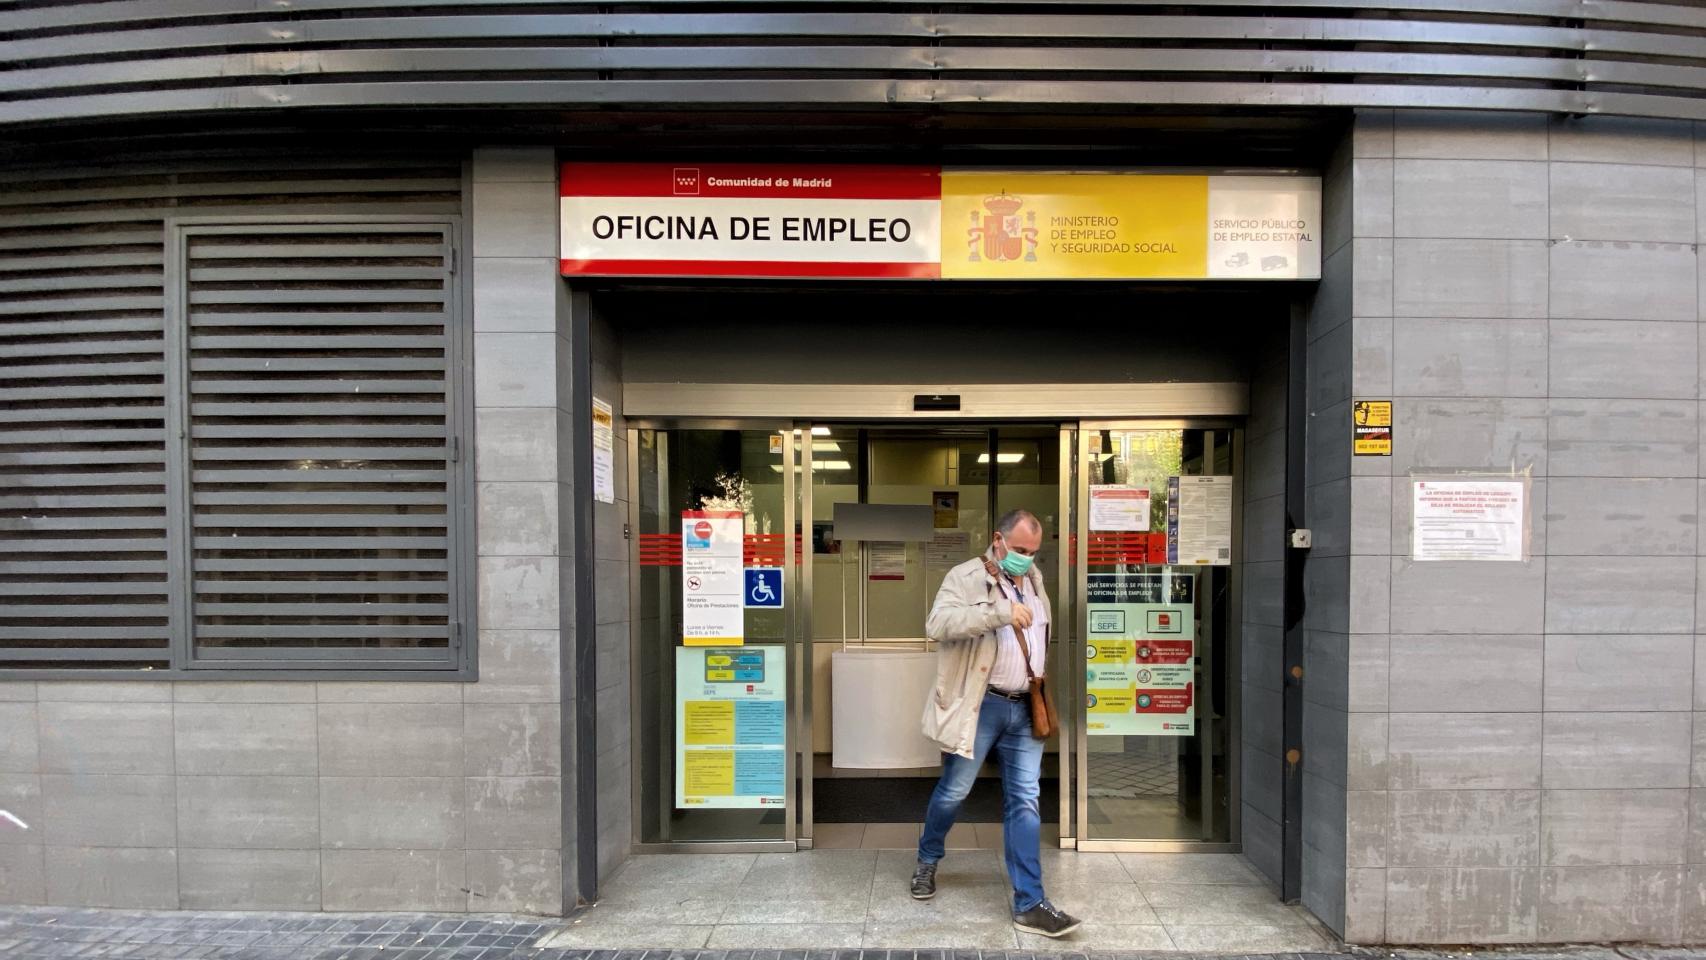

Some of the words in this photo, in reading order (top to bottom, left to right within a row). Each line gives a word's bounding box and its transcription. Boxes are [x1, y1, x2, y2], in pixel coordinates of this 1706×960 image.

[707, 176, 772, 189] Comunidad
[775, 177, 791, 189] de
[792, 177, 833, 189] Madrid
[1050, 215, 1119, 227] MINISTERIO
[1213, 219, 1259, 230] SERVICIO
[1261, 217, 1306, 230] PÚBLICO
[591, 215, 719, 241] OFICINA
[730, 216, 771, 241] DE
[781, 217, 912, 243] EMPLEO
[1050, 229, 1067, 240] DE
[1070, 229, 1117, 240] EMPLEO
[1213, 232, 1228, 243] DE
[1230, 232, 1271, 243] EMPLEO
[1272, 232, 1313, 243] ESTATAL
[1050, 242, 1059, 254] Y
[1061, 242, 1131, 254] SEGURIDAD
[1134, 243, 1178, 254] SOCIAL
